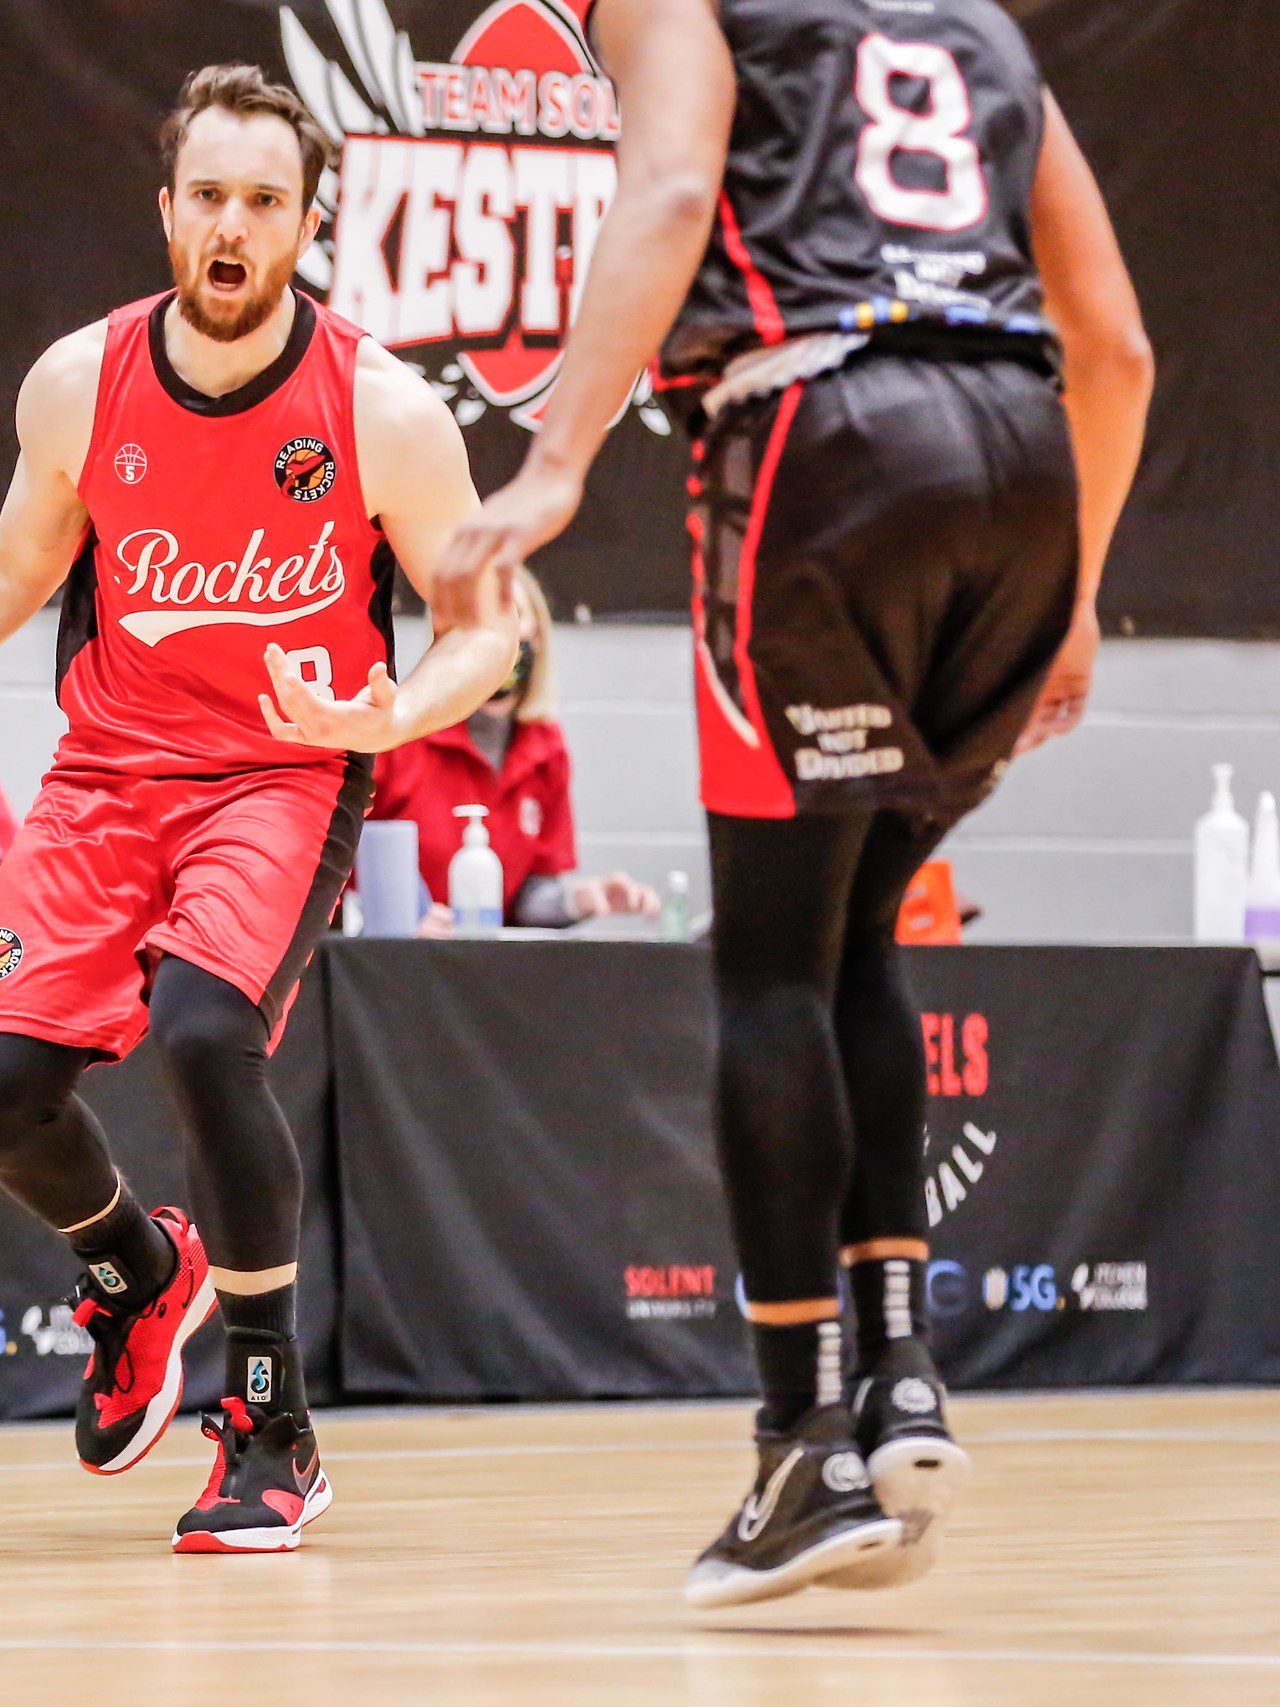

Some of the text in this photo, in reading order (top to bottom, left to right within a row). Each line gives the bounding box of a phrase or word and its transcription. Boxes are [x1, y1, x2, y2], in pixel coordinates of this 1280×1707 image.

[416, 64, 621, 141] TEAM SOL
[854, 32, 989, 232] 8
[329, 134, 619, 348] KESTR
[125, 465, 135, 481] 5
[276, 438, 335, 501] READING ROCKETS
[115, 520, 347, 606] Rockets
